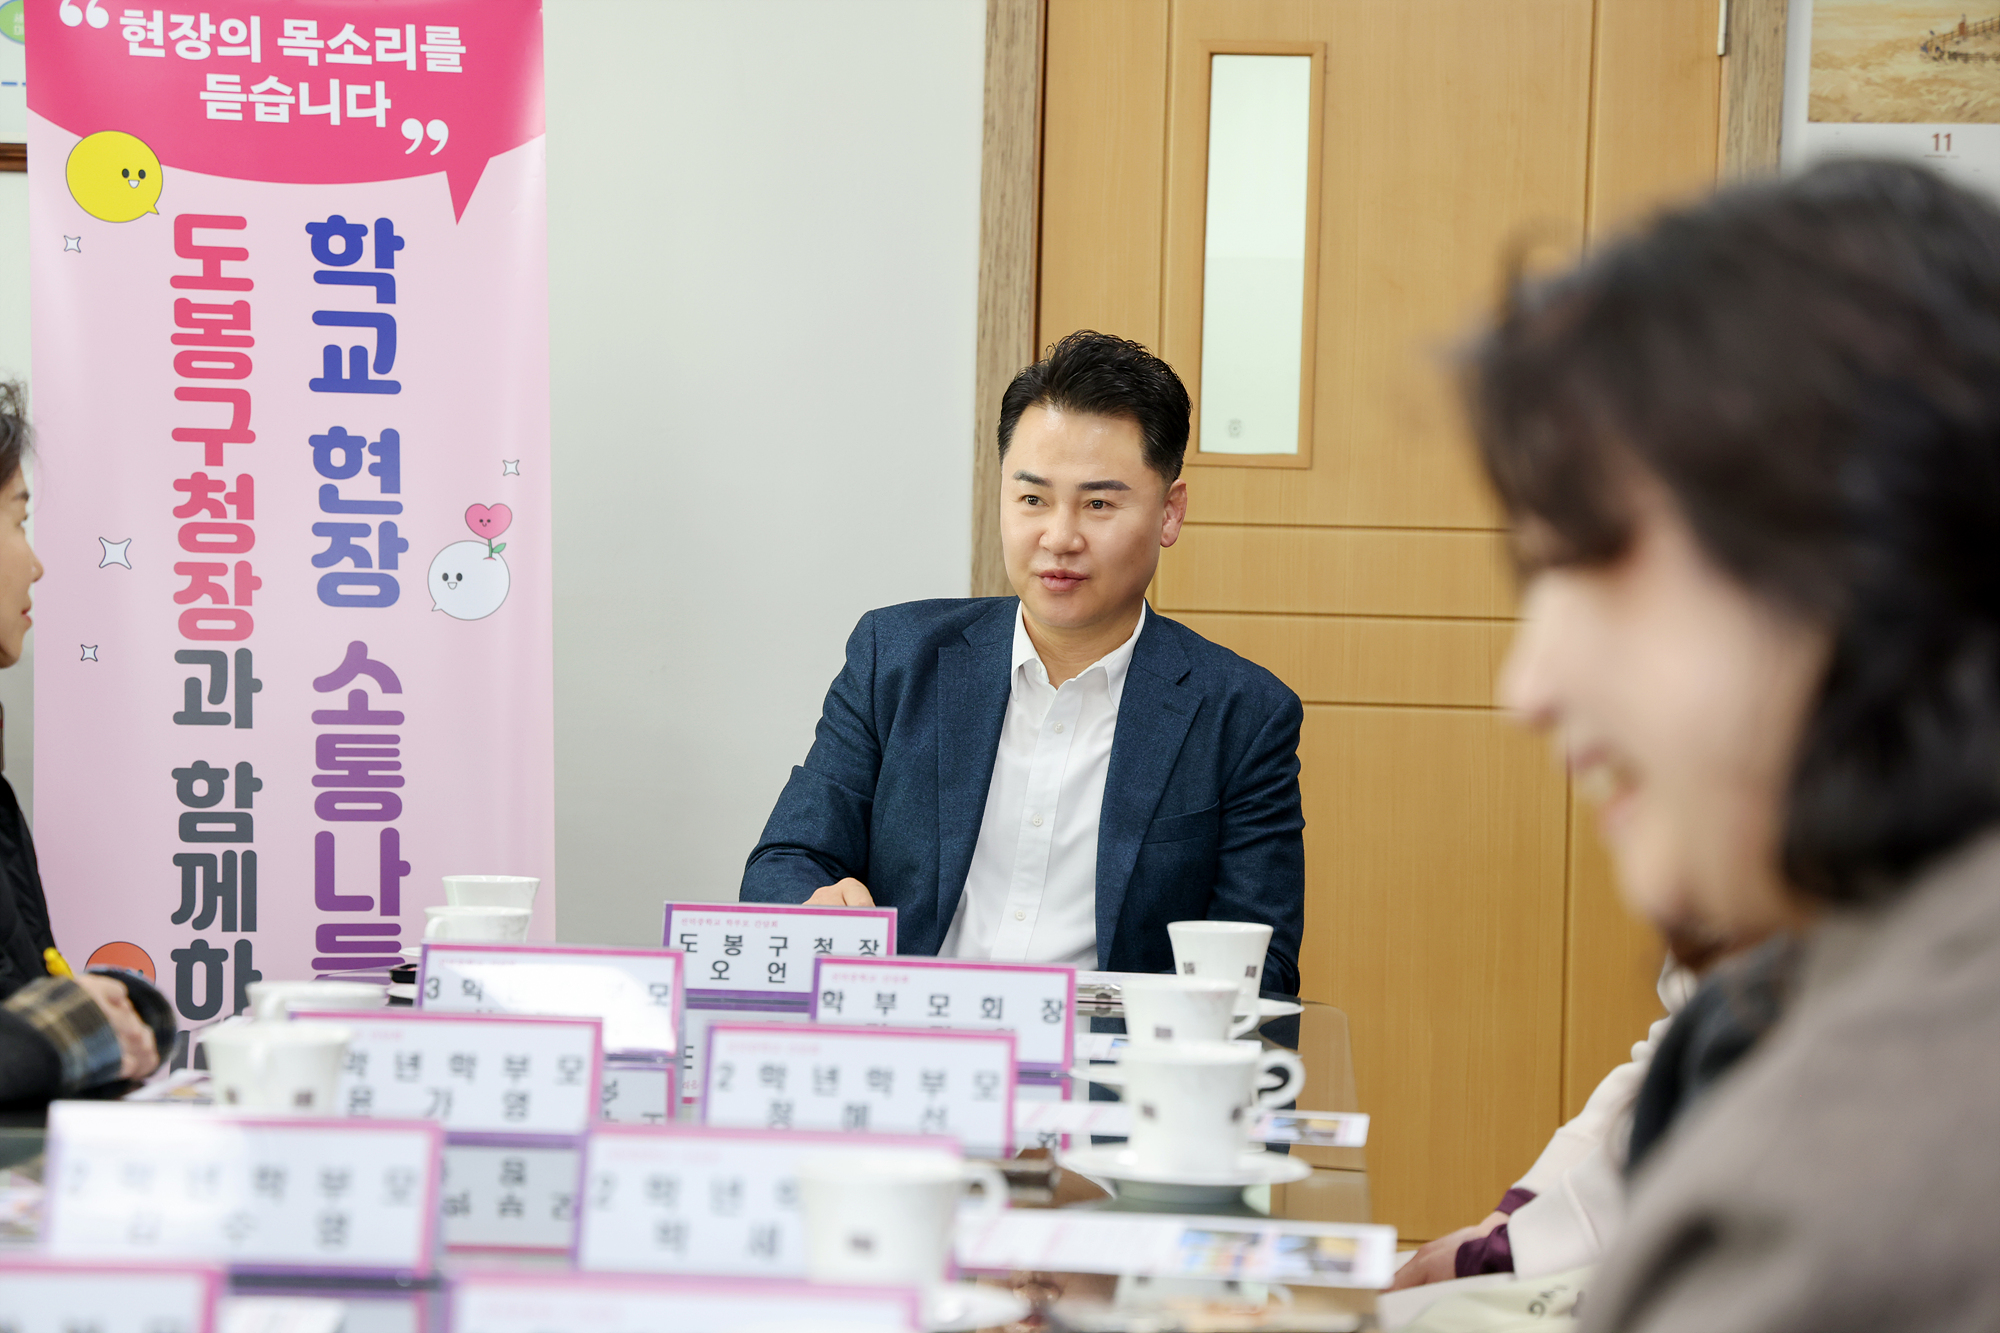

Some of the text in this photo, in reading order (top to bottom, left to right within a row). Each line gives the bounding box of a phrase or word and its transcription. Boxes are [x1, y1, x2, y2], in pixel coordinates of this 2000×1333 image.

[119, 9, 467, 74] 현장의 목소리를
[200, 72, 392, 127] 듣습니다
[1931, 132, 1951, 152] 11
[305, 214, 405, 395] 학교
[308, 426, 409, 608] 현장
[170, 213, 263, 1076] 도봉구청장과 함께하
